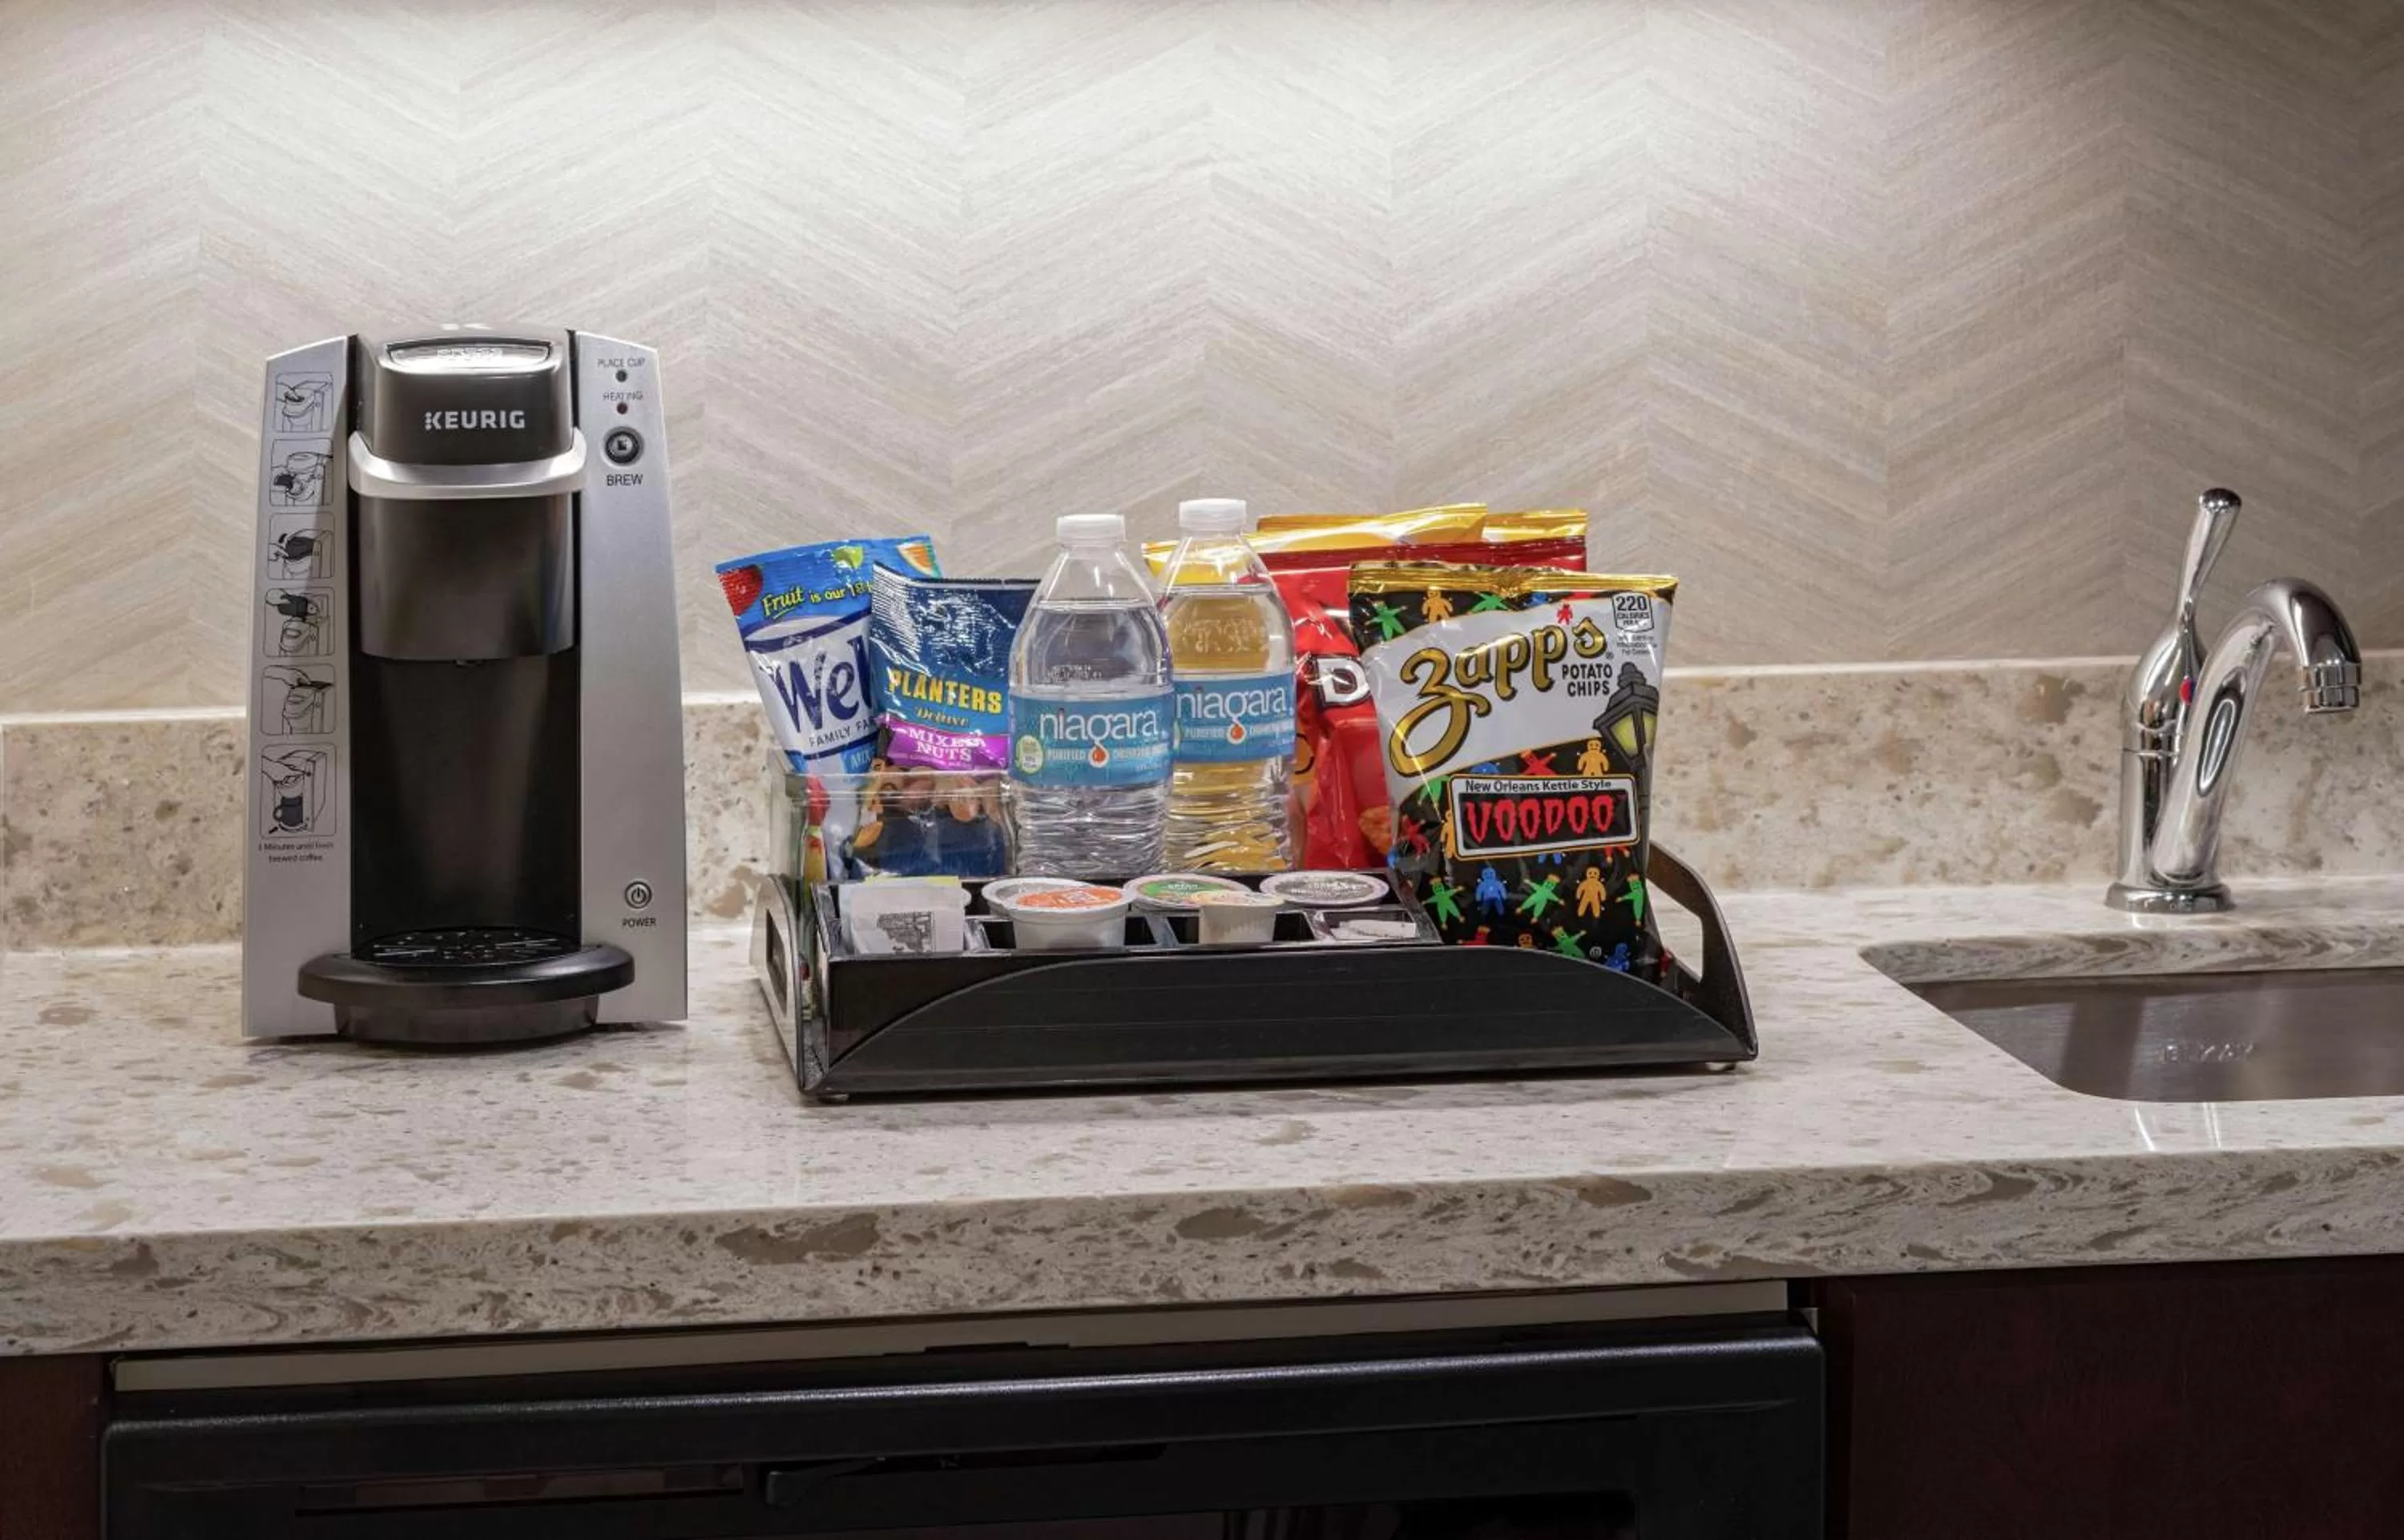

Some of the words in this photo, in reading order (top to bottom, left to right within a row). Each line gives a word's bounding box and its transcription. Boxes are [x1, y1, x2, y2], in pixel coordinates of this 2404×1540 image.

[597, 359, 625, 368] PLACE
[627, 357, 645, 367] CUP
[603, 391, 643, 401] HEATING
[425, 409, 526, 430] KEURIG
[607, 474, 643, 486] BREW
[762, 586, 804, 617] Fruit
[809, 589, 821, 603] is
[824, 588, 845, 600] our
[1615, 595, 1648, 611] 220
[1562, 663, 1612, 679] POTATO
[889, 669, 1002, 714] PLANTERS
[1567, 681, 1610, 697] CHIPS
[1176, 678, 1286, 721] niagara
[1039, 708, 1160, 744] niagara
[809, 726, 851, 748] FAMILY
[916, 741, 972, 762] NUTS
[1466, 780, 1490, 792] New
[1493, 780, 1541, 792] Orleans
[1543, 780, 1579, 790] Kettle
[1581, 780, 1611, 790] Style
[1466, 794, 1614, 844] VOODOO
[622, 917, 657, 928] POWER
